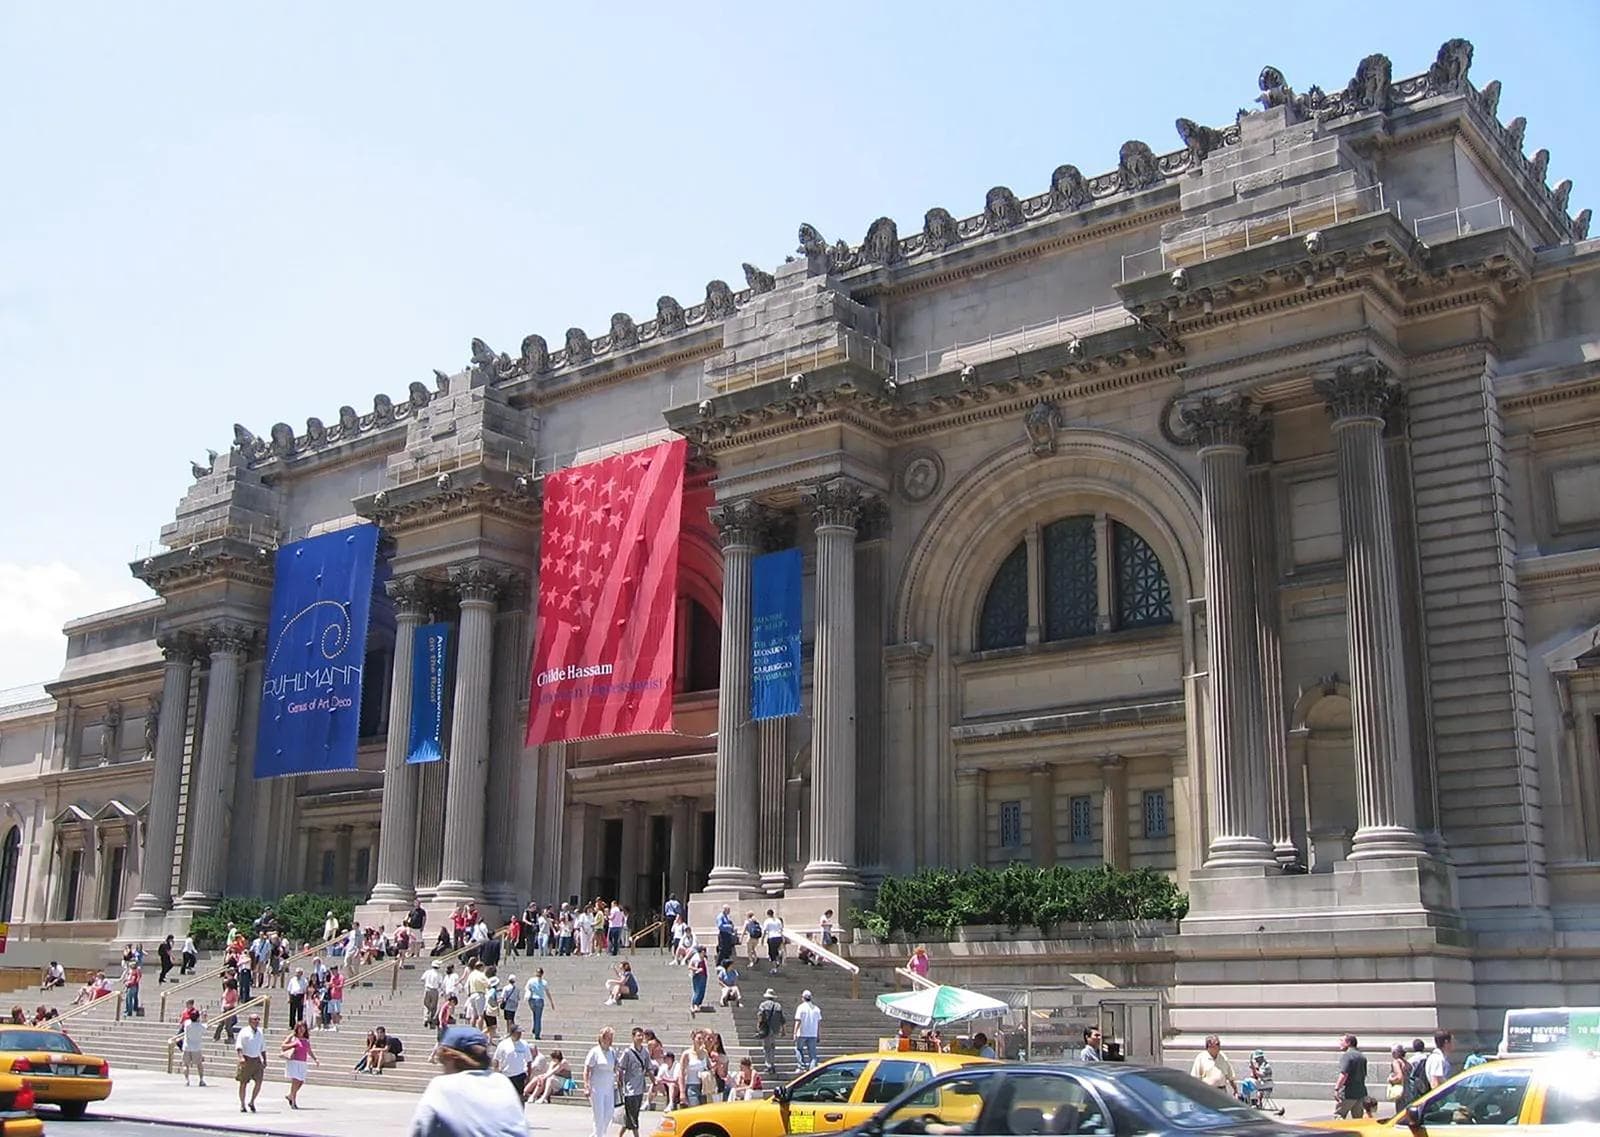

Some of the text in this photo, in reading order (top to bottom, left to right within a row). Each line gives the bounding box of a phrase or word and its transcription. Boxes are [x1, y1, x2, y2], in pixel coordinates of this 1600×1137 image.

[262, 664, 363, 700] RUHLMANN
[536, 663, 613, 687] Childe Hassam
[309, 699, 317, 711] of
[318, 698, 330, 710] Art
[331, 696, 352, 708] Deco
[1509, 1026, 1532, 1034] FROM
[1577, 1026, 1588, 1034] TO
